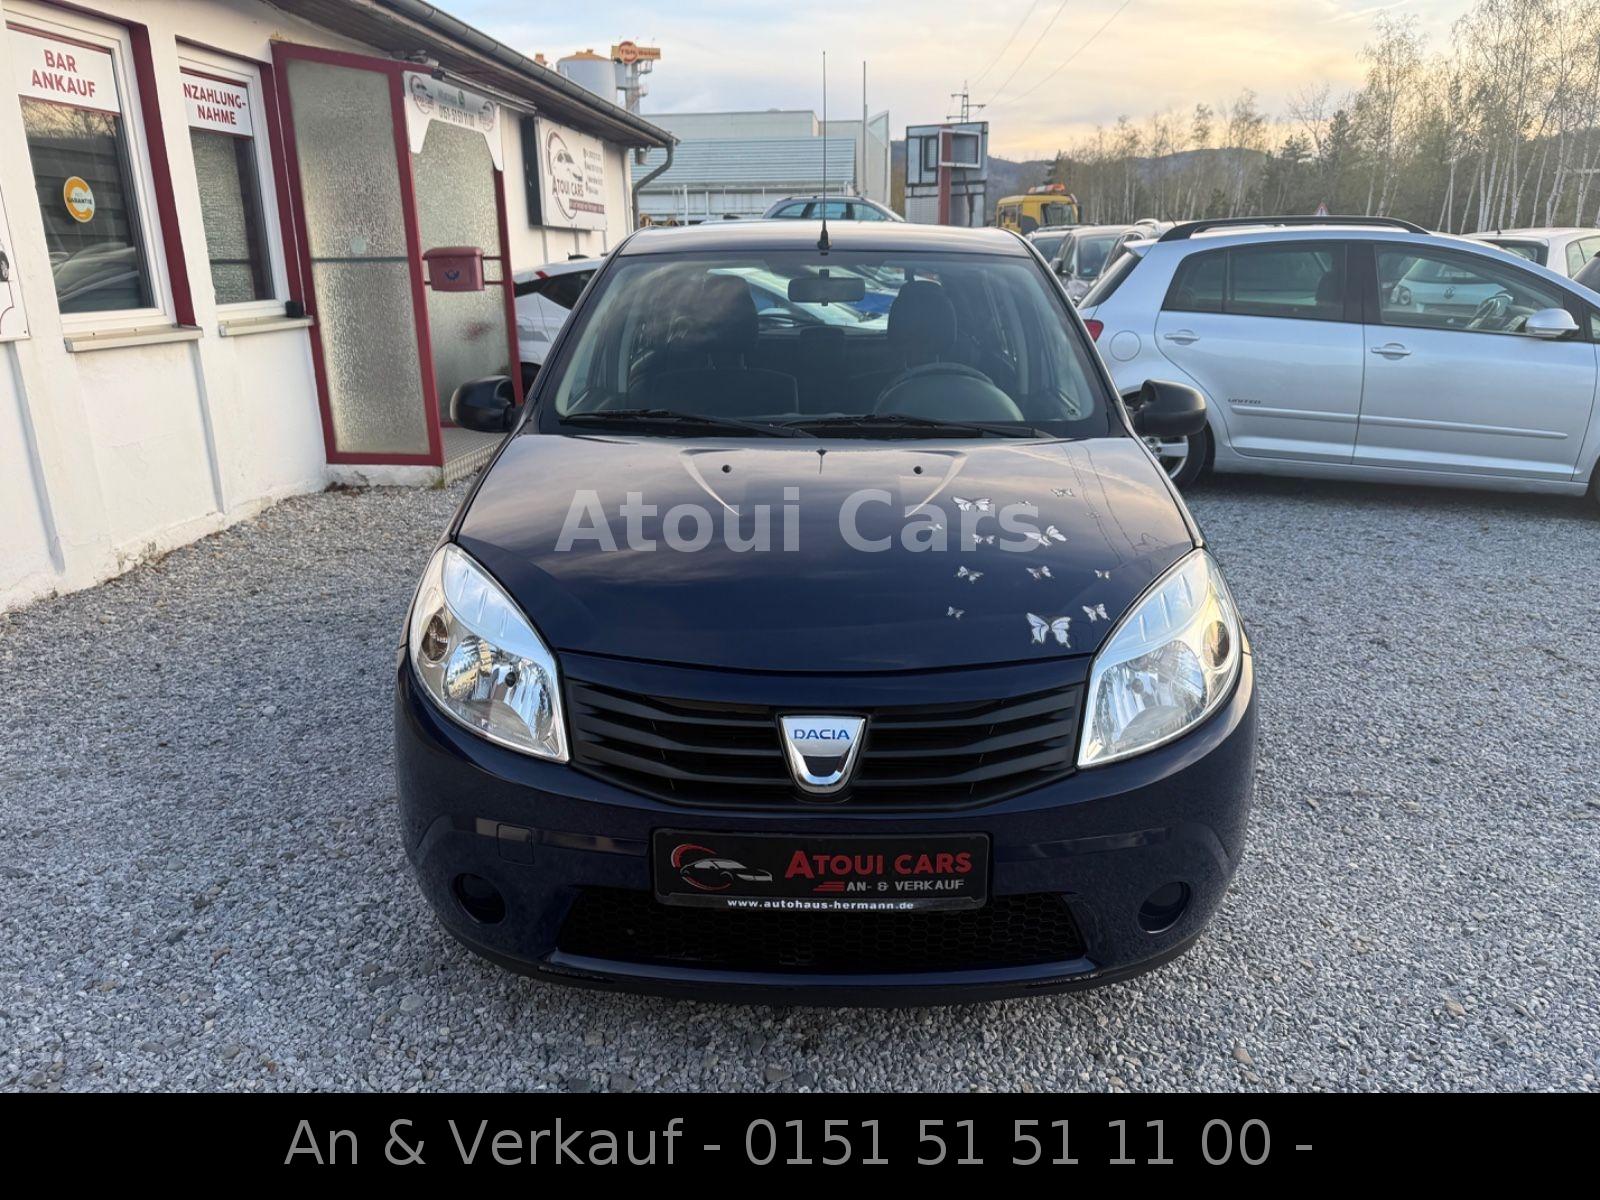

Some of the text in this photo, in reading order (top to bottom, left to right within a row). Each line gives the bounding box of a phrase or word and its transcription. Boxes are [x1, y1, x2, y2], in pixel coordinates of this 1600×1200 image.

[44, 50, 77, 73] BAR
[31, 69, 96, 98] ANKAUF
[182, 82, 247, 109] NZAHLUNG-
[197, 104, 237, 125] NAHME
[793, 728, 850, 740] DACIA
[846, 879, 964, 892] AN- & VERKAUF
[727, 898, 914, 910] www.autohaus-hermann.de
